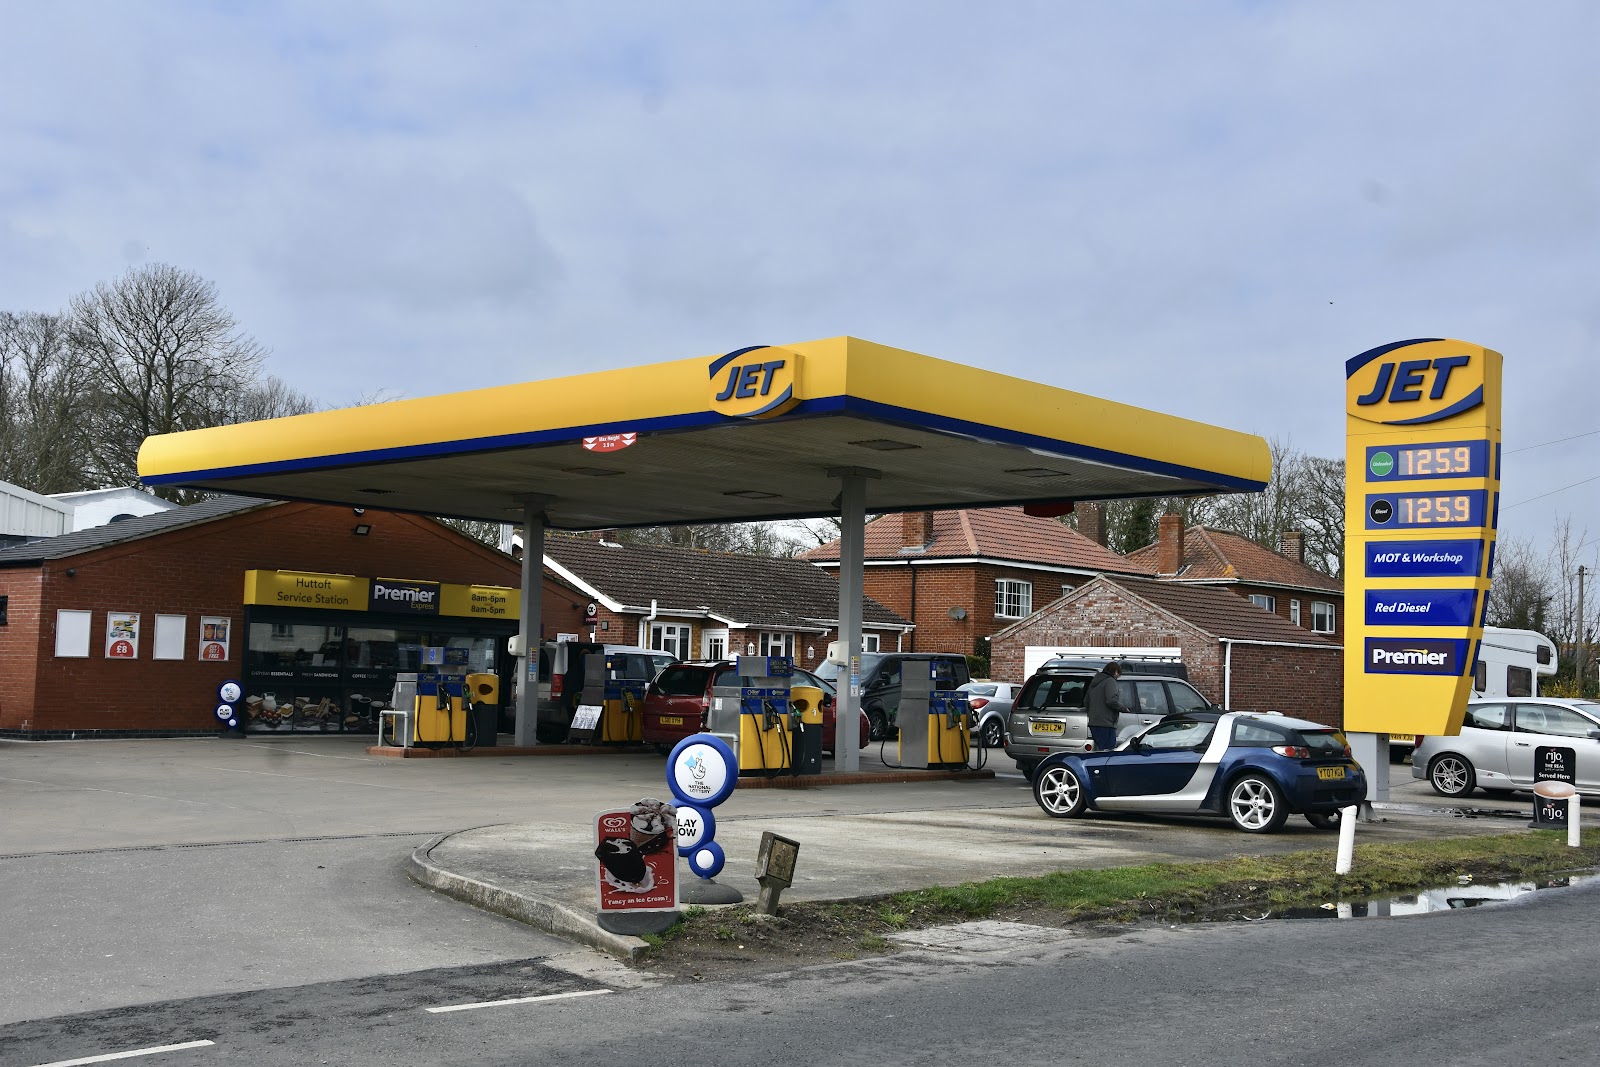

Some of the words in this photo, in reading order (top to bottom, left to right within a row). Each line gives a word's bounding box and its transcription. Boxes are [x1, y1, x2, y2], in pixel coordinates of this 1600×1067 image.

[715, 359, 786, 402] JET
[1356, 355, 1471, 406] JET
[1406, 447, 1469, 475] 125.9
[1406, 496, 1469, 524] 125.9
[1374, 554, 1400, 563] MOT
[1402, 554, 1411, 562] &
[1412, 553, 1463, 564] Workshop
[296, 578, 331, 589] Huttoft
[278, 592, 312, 602] Service
[315, 594, 348, 604] Station
[374, 584, 434, 602] Premier
[411, 602, 434, 610] Express
[1375, 603, 1396, 612] Red
[1398, 602, 1431, 612] Diesel
[116, 646, 128, 654] £8
[1372, 649, 1448, 665] Premier
[1542, 808, 1562, 820] rijo
[678, 819, 697, 828] LAY
